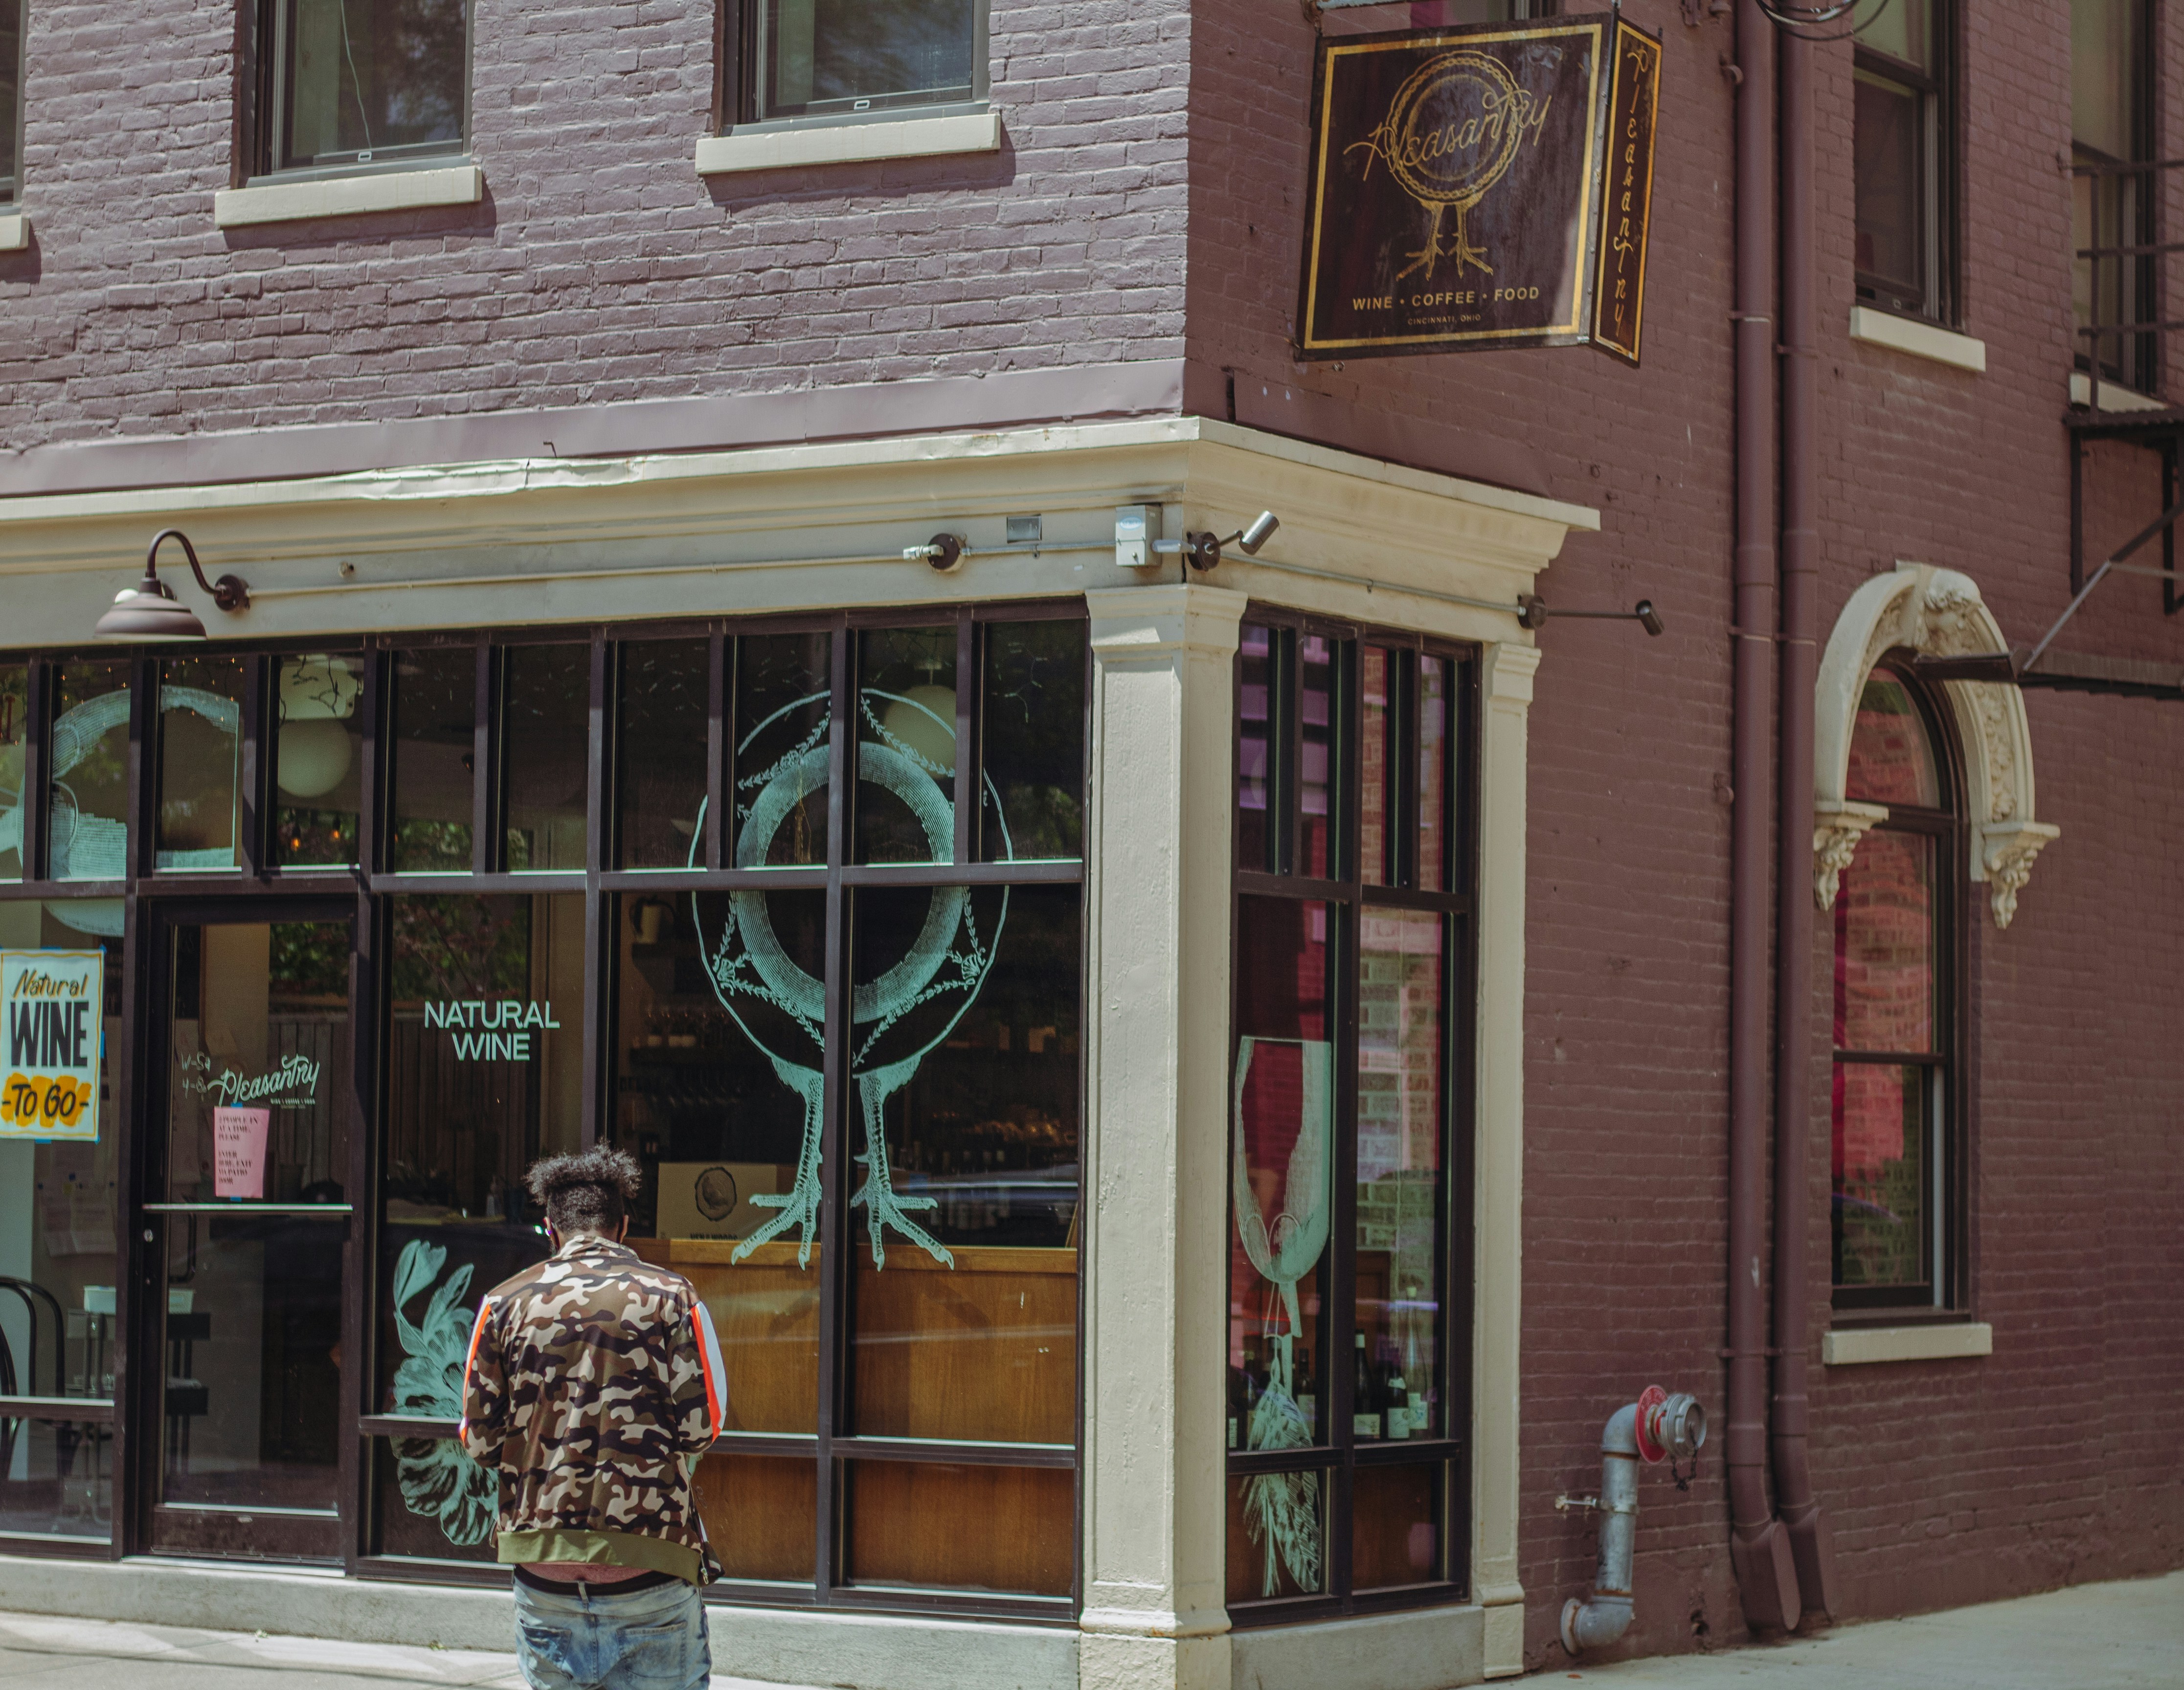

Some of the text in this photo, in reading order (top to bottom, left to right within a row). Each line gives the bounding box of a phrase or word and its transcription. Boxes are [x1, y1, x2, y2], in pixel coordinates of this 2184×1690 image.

[1343, 89, 1552, 181] Pleasantry
[1352, 286, 1539, 311] WINE COFFEE FOOD
[1407, 313, 1482, 326] CINCINNATI, OHIO
[11, 968, 89, 999] Natural
[425, 1000, 560, 1029] NATURAL
[10, 1000, 90, 1068] WINE
[451, 1032, 530, 1061] WINE
[207, 1053, 320, 1107] Pleasantry
